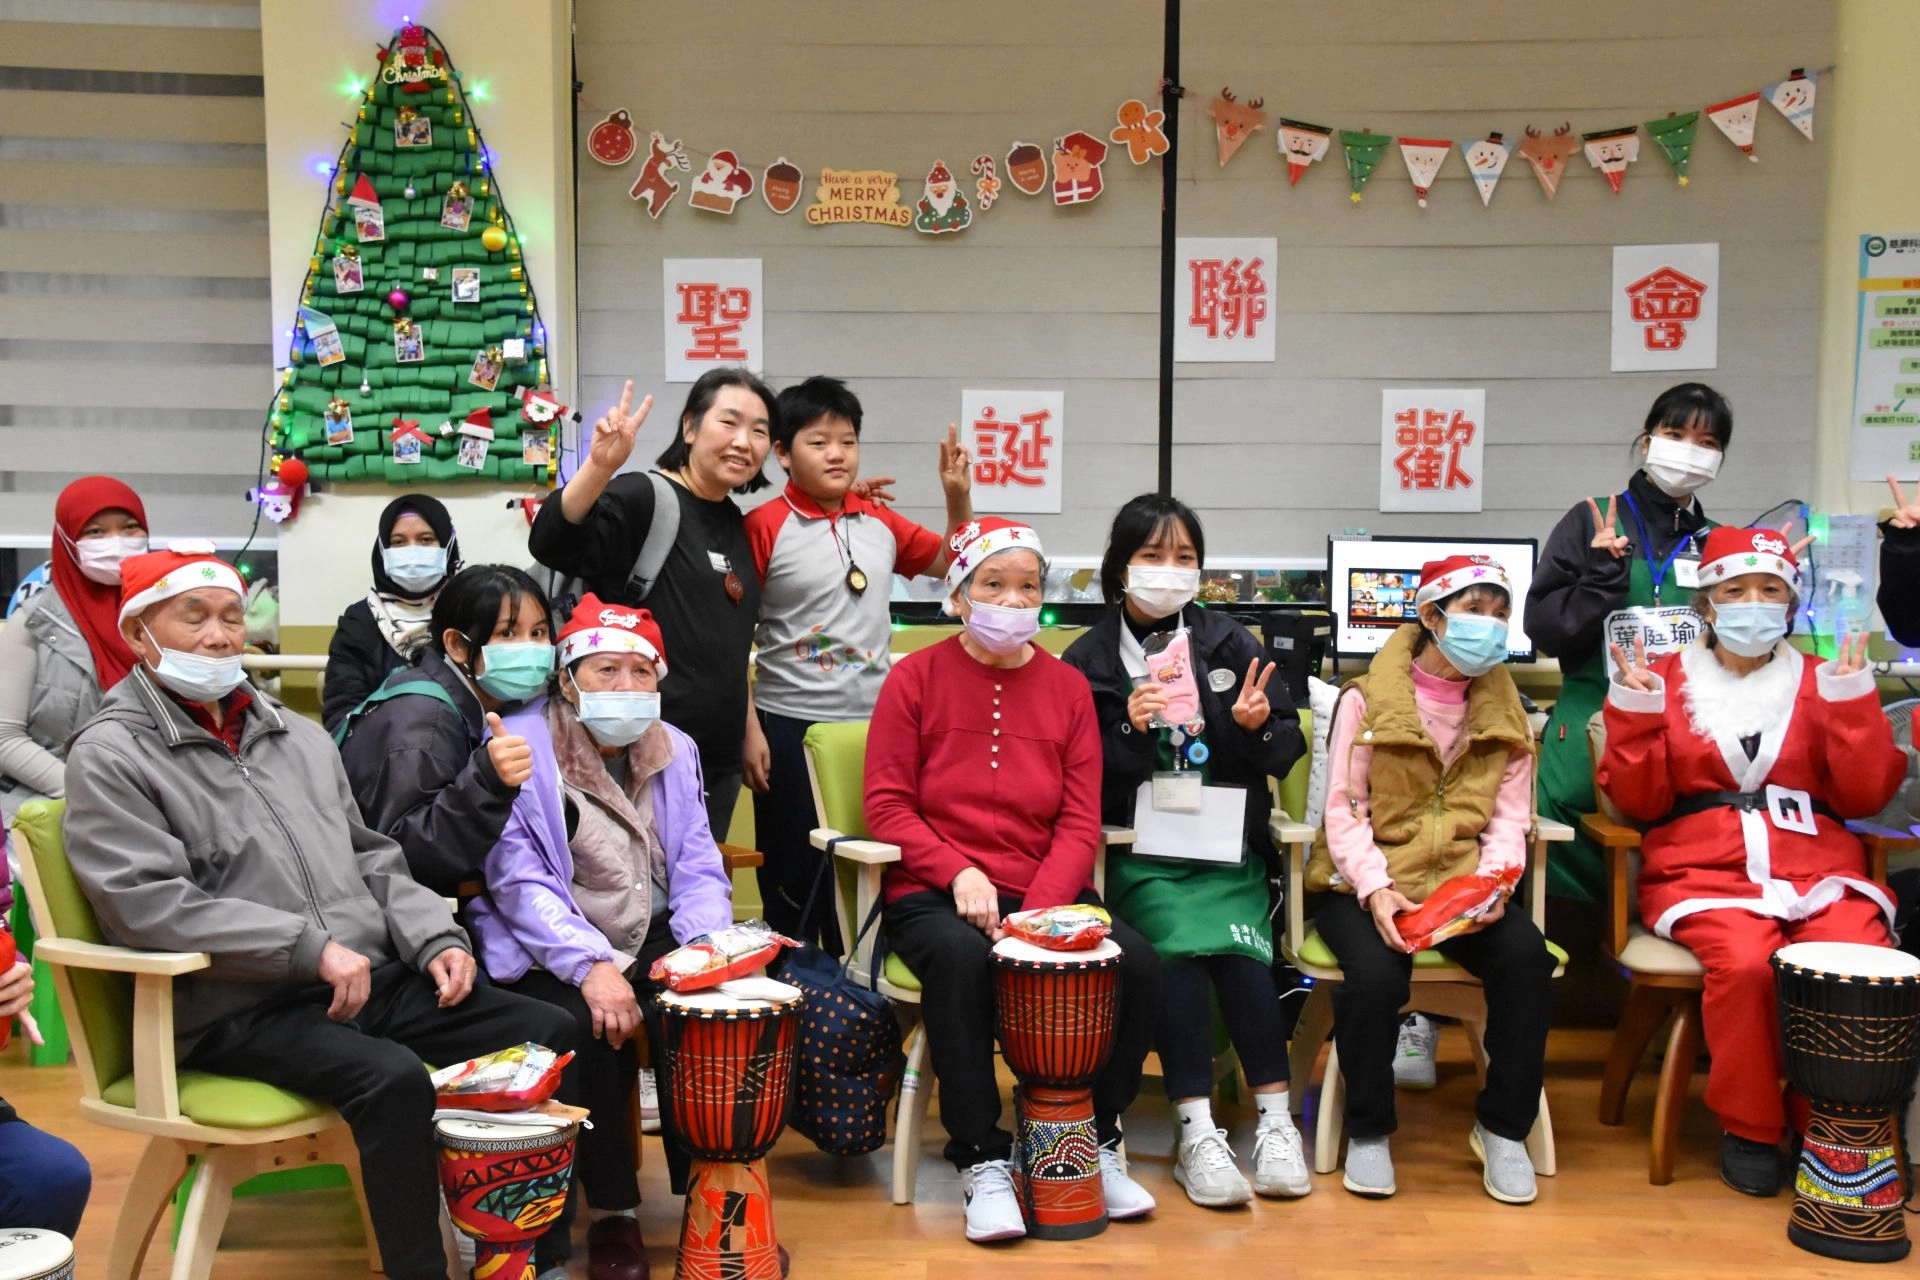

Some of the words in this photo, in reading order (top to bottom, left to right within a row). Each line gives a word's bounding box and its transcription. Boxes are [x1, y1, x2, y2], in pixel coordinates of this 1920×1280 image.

[808, 206, 910, 224] CHRISTMAS
[822, 173, 850, 185] Have
[853, 177, 864, 185] a
[867, 175, 896, 187] very
[830, 188, 888, 201] MERRY
[675, 282, 752, 362] 聖
[1187, 256, 1268, 340] 聯
[1624, 265, 1709, 352] 會
[972, 405, 1053, 488] 誕
[1393, 407, 1476, 491] 歡
[1613, 621, 1696, 649] 葉庭瑜
